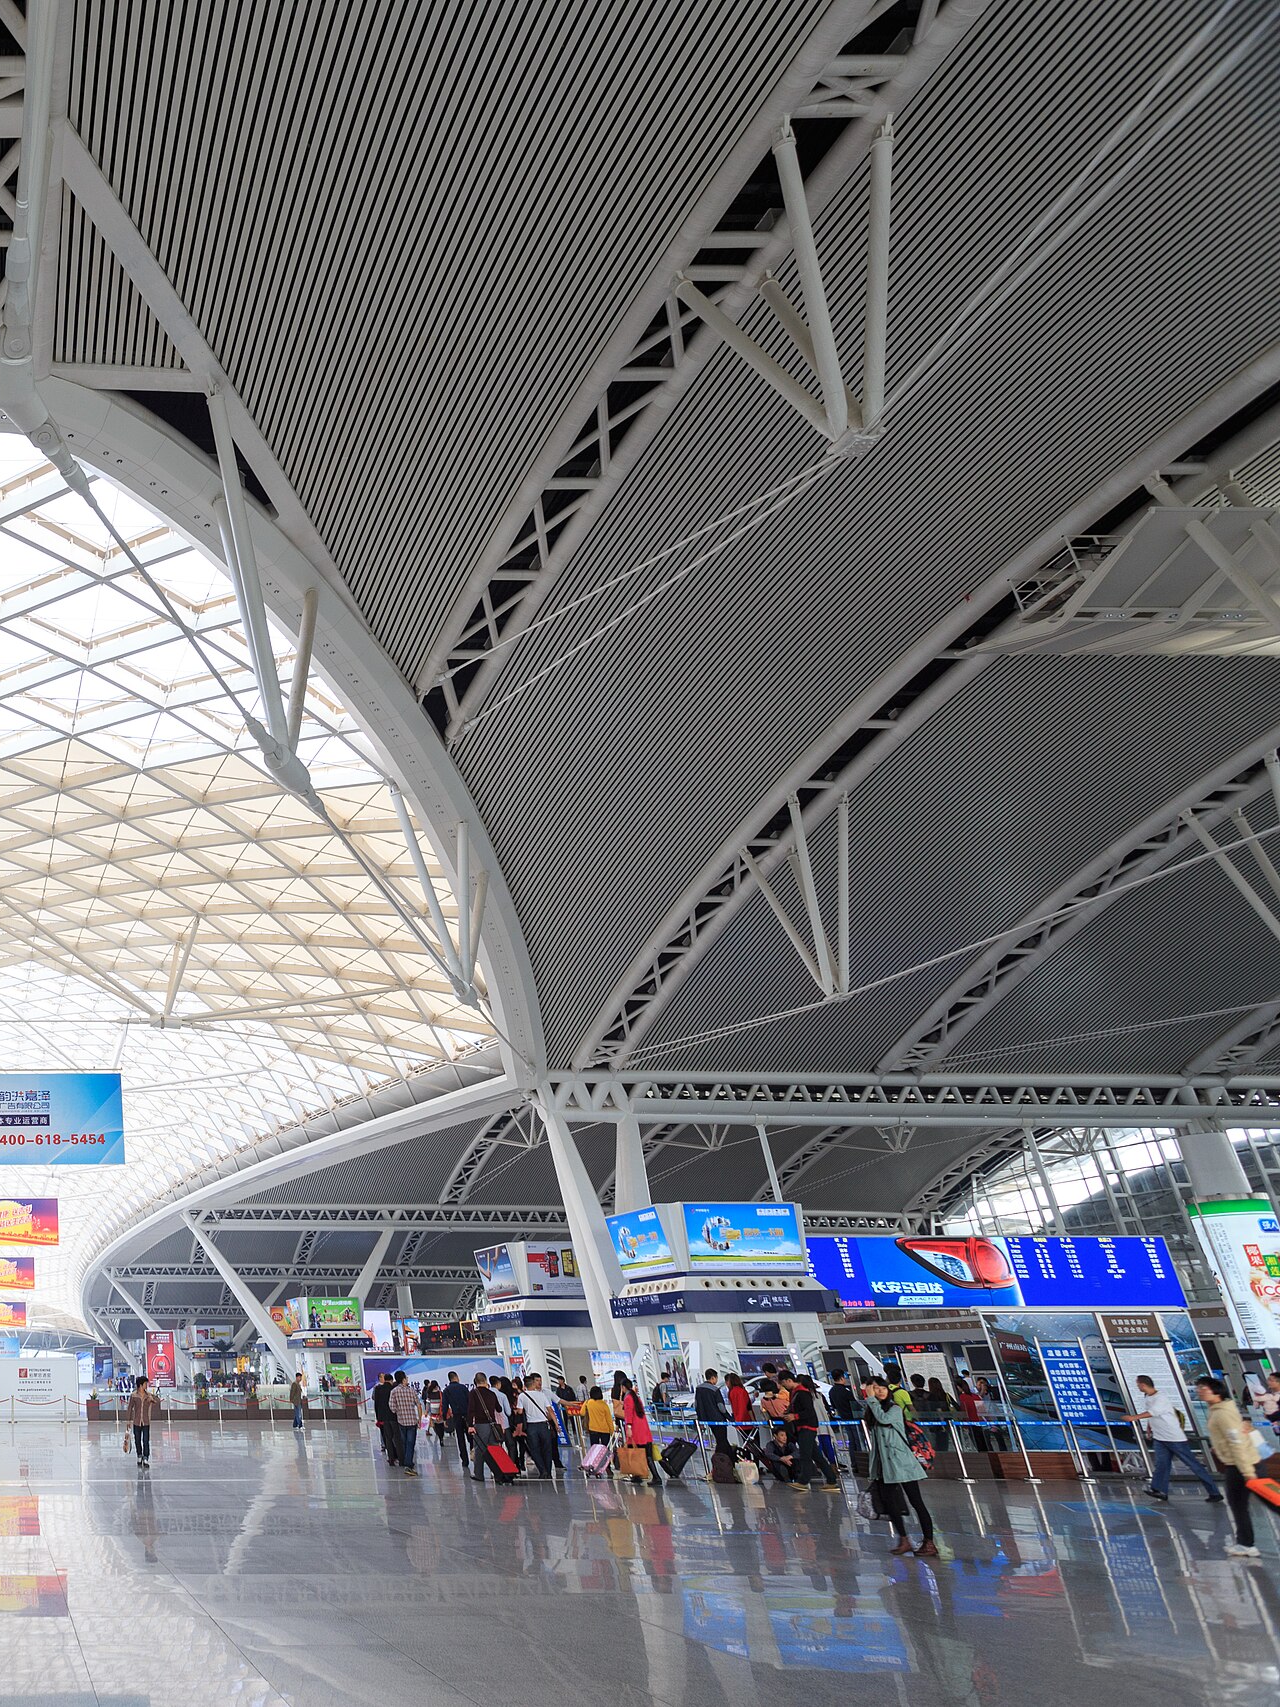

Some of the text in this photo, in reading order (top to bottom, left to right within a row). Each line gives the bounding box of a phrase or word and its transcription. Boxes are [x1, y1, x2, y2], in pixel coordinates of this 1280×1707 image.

[0, 1133, 106, 1146] 400-618-5454
[1245, 1245, 1263, 1266] 椰果
[870, 1281, 945, 1294] 长安马自达
